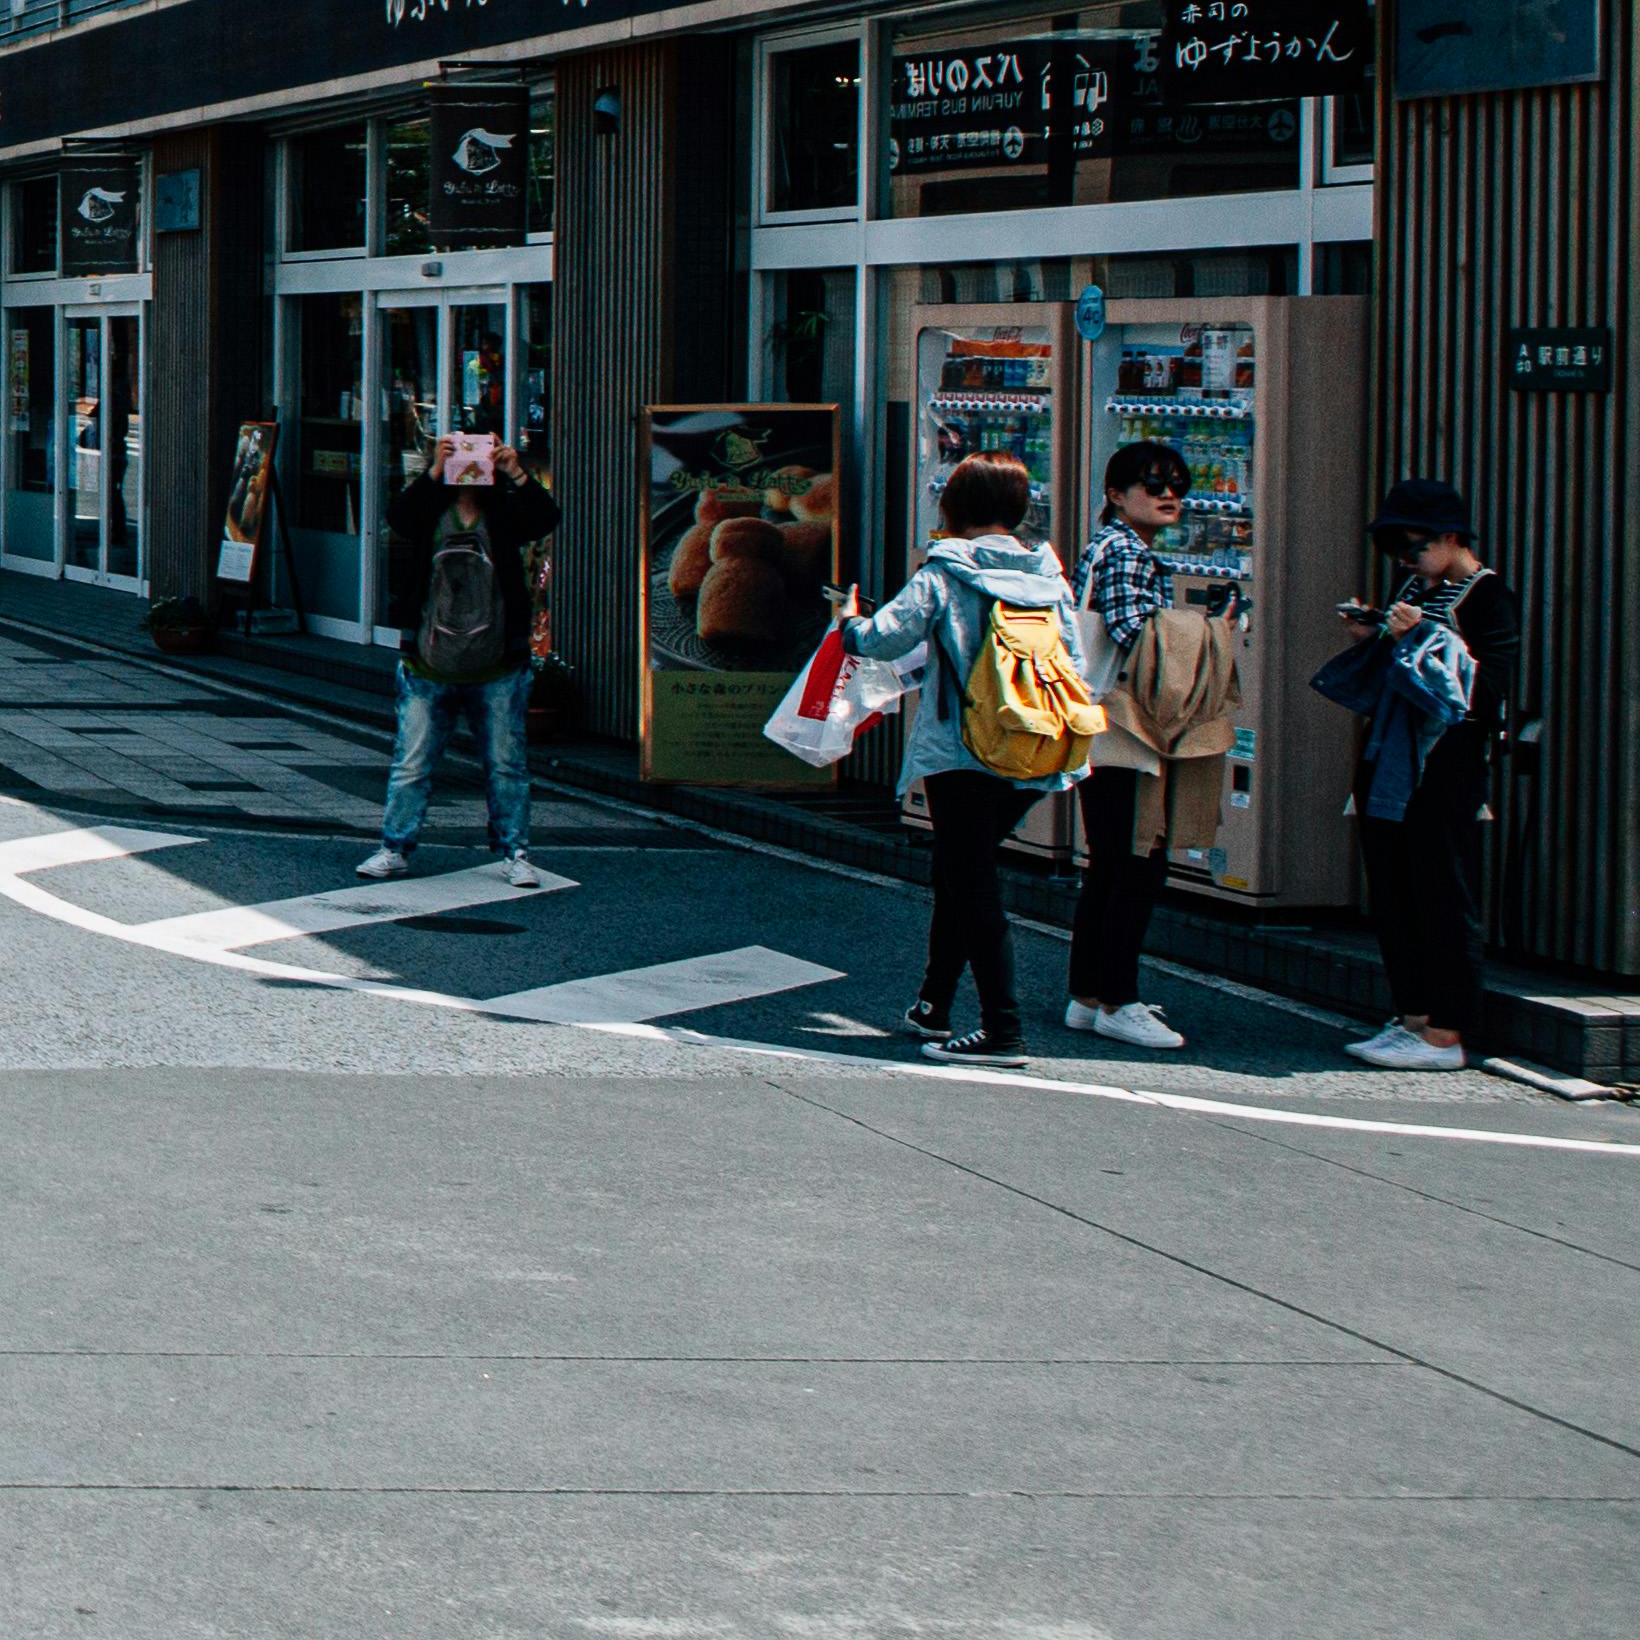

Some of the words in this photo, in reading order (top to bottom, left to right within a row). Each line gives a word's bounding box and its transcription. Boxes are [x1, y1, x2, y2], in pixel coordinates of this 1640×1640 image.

[1175, 20, 1356, 72] ゆずようかん
